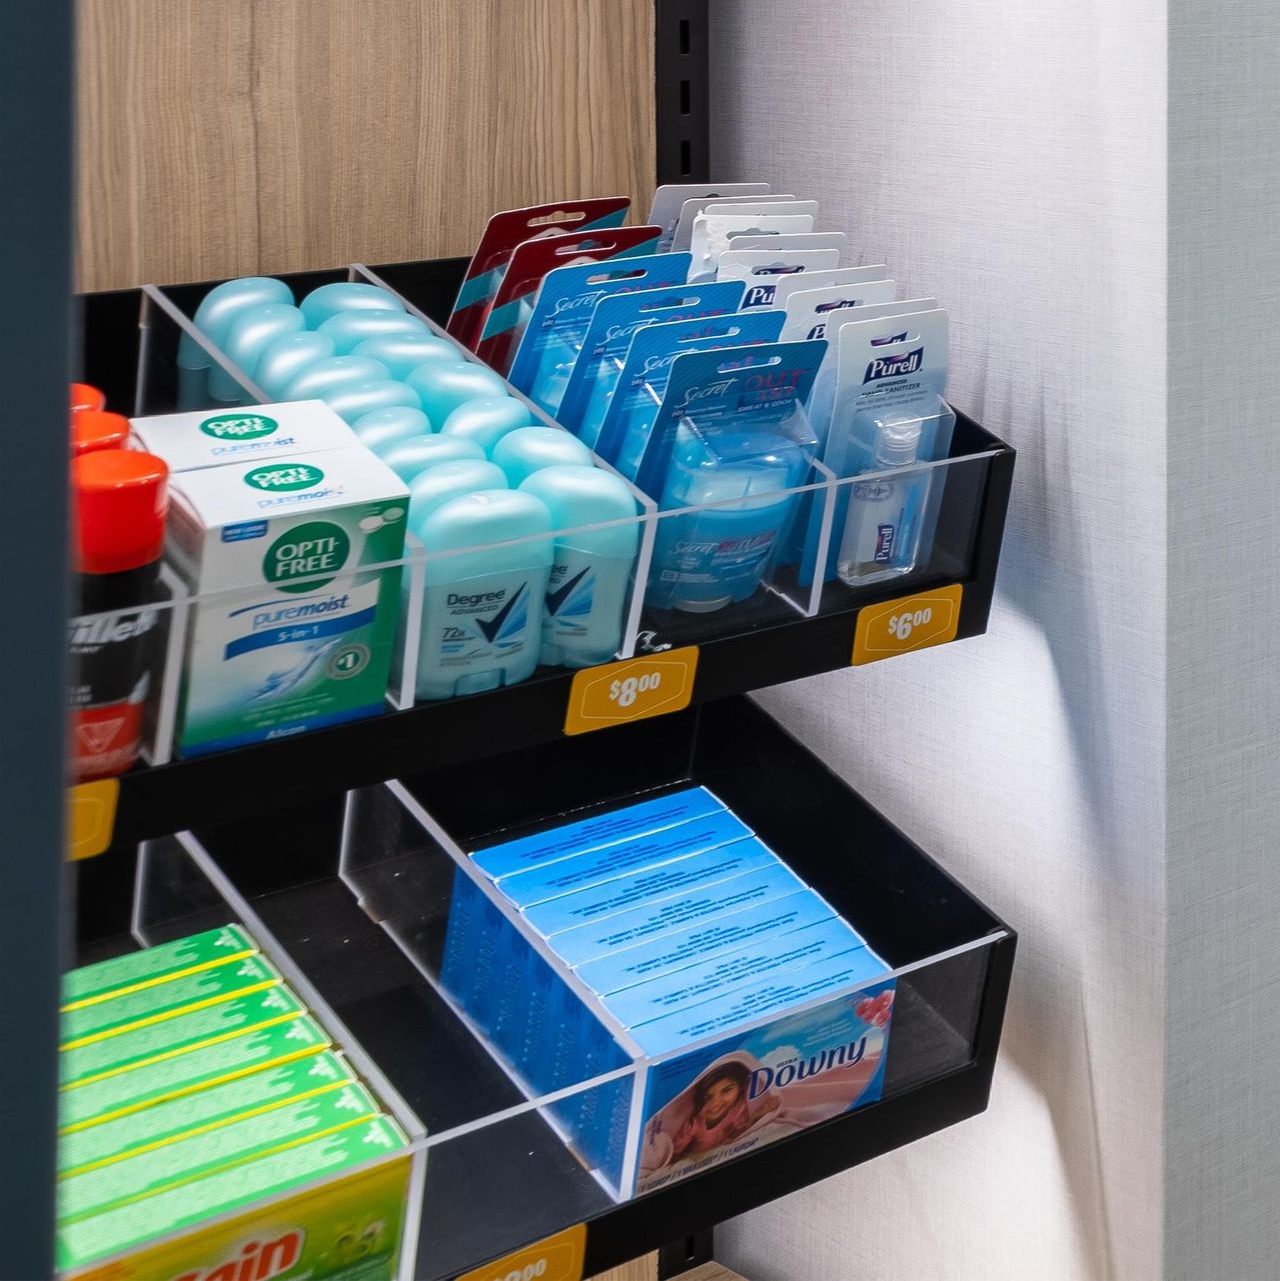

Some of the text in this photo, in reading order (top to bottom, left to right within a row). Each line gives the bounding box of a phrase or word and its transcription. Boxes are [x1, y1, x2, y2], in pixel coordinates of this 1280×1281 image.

[545, 289, 607, 318] Secret
[870, 354, 918, 378] Purell
[673, 377, 738, 409] Secret
[887, 382, 921, 394] SANITIZER
[876, 527, 893, 561] Purell
[275, 552, 336, 577] FREE
[446, 589, 507, 607] Degree
[449, 604, 499, 616] ADVANCED
[252, 594, 350, 630] puremoist
[278, 625, 319, 641] 5-in-1
[266, 724, 307, 740] Alcon
[748, 1036, 867, 1100] Downy
